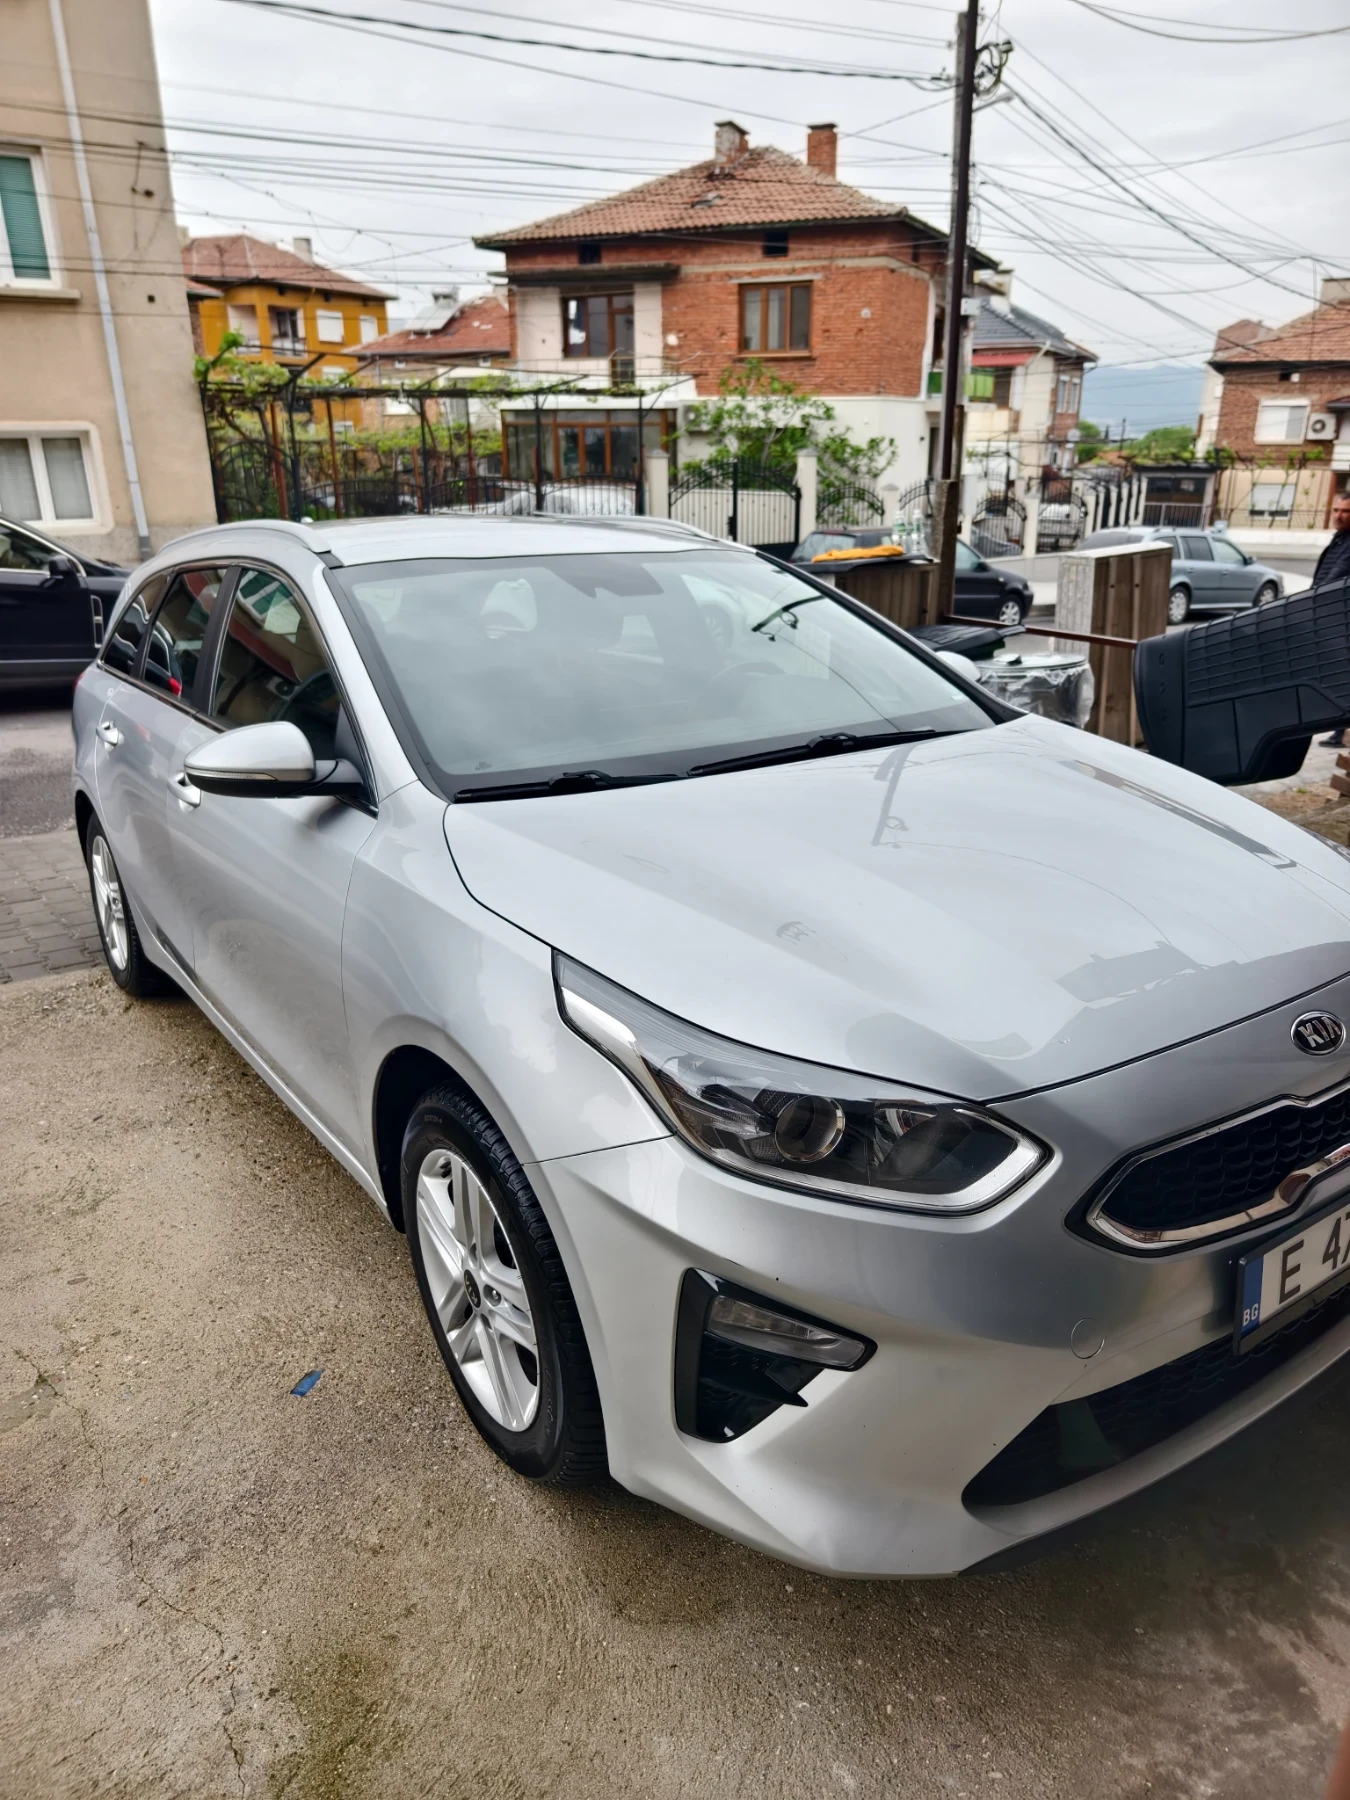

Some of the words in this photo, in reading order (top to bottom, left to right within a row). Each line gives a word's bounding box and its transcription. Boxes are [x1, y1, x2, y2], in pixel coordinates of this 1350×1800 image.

[1297, 1016, 1341, 1048] KIA
[1279, 1239, 1305, 1305] E
[1242, 1303, 1259, 1327] BG
